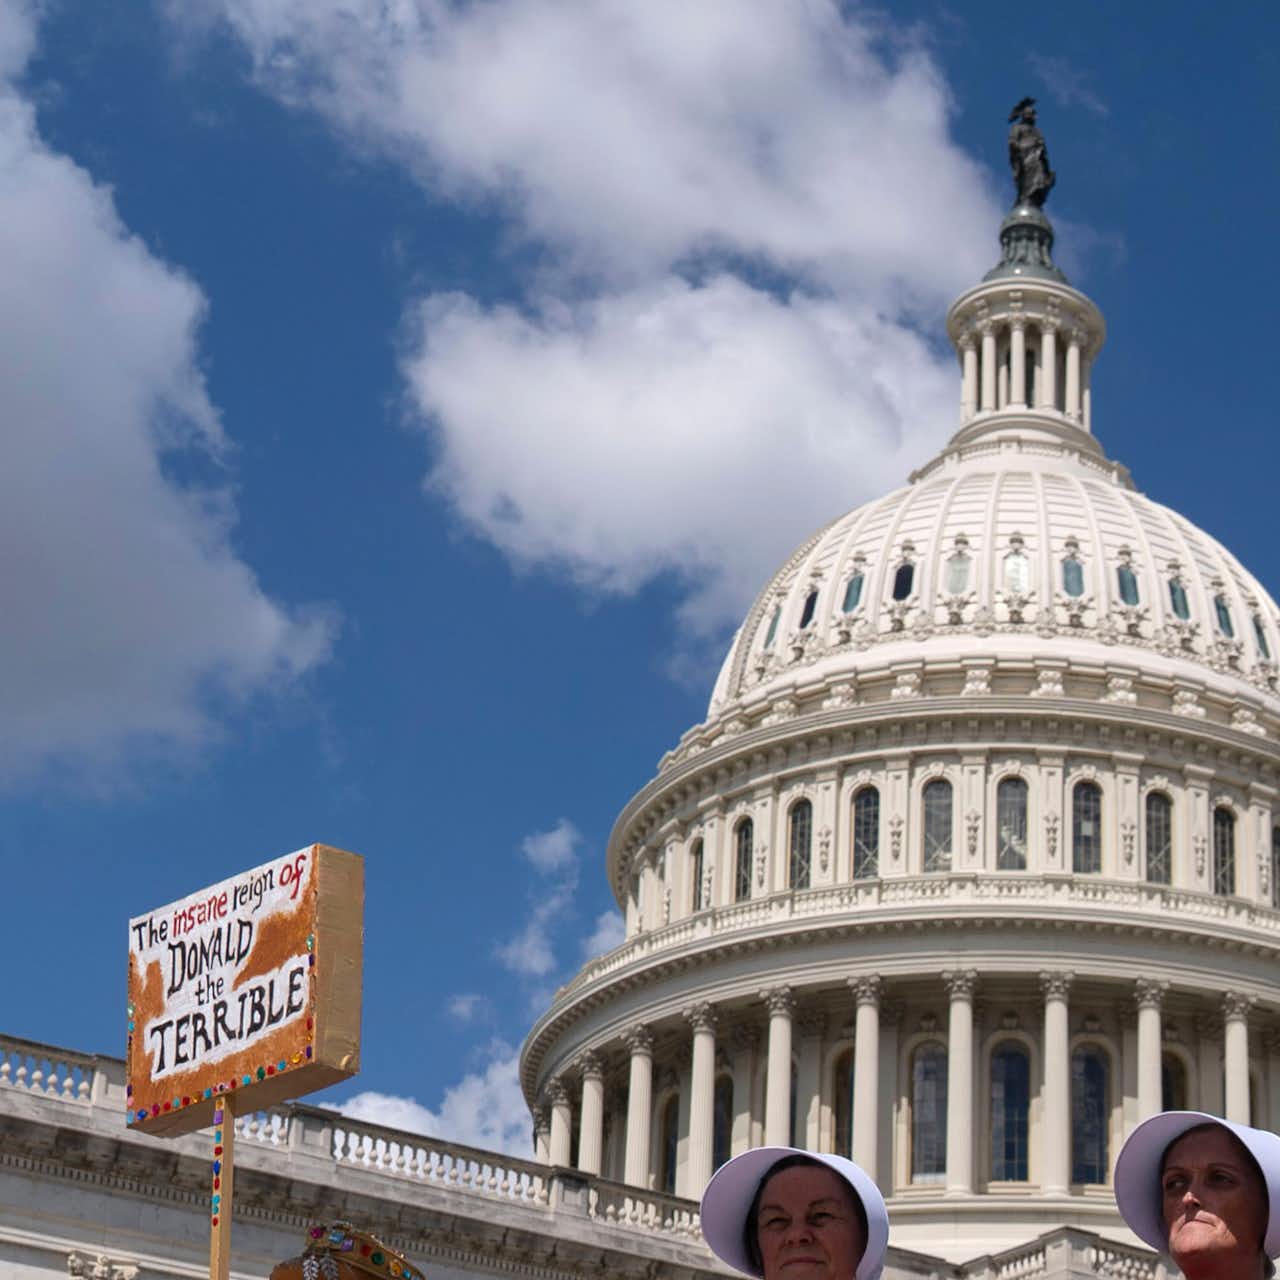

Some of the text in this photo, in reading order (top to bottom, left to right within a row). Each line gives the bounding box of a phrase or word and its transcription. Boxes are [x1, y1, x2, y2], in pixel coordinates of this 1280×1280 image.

[132, 855, 307, 951] The insane reign of
[167, 918, 253, 1000] DONALD
[195, 974, 224, 1006] the
[150, 967, 305, 1074] TERRIBLE
